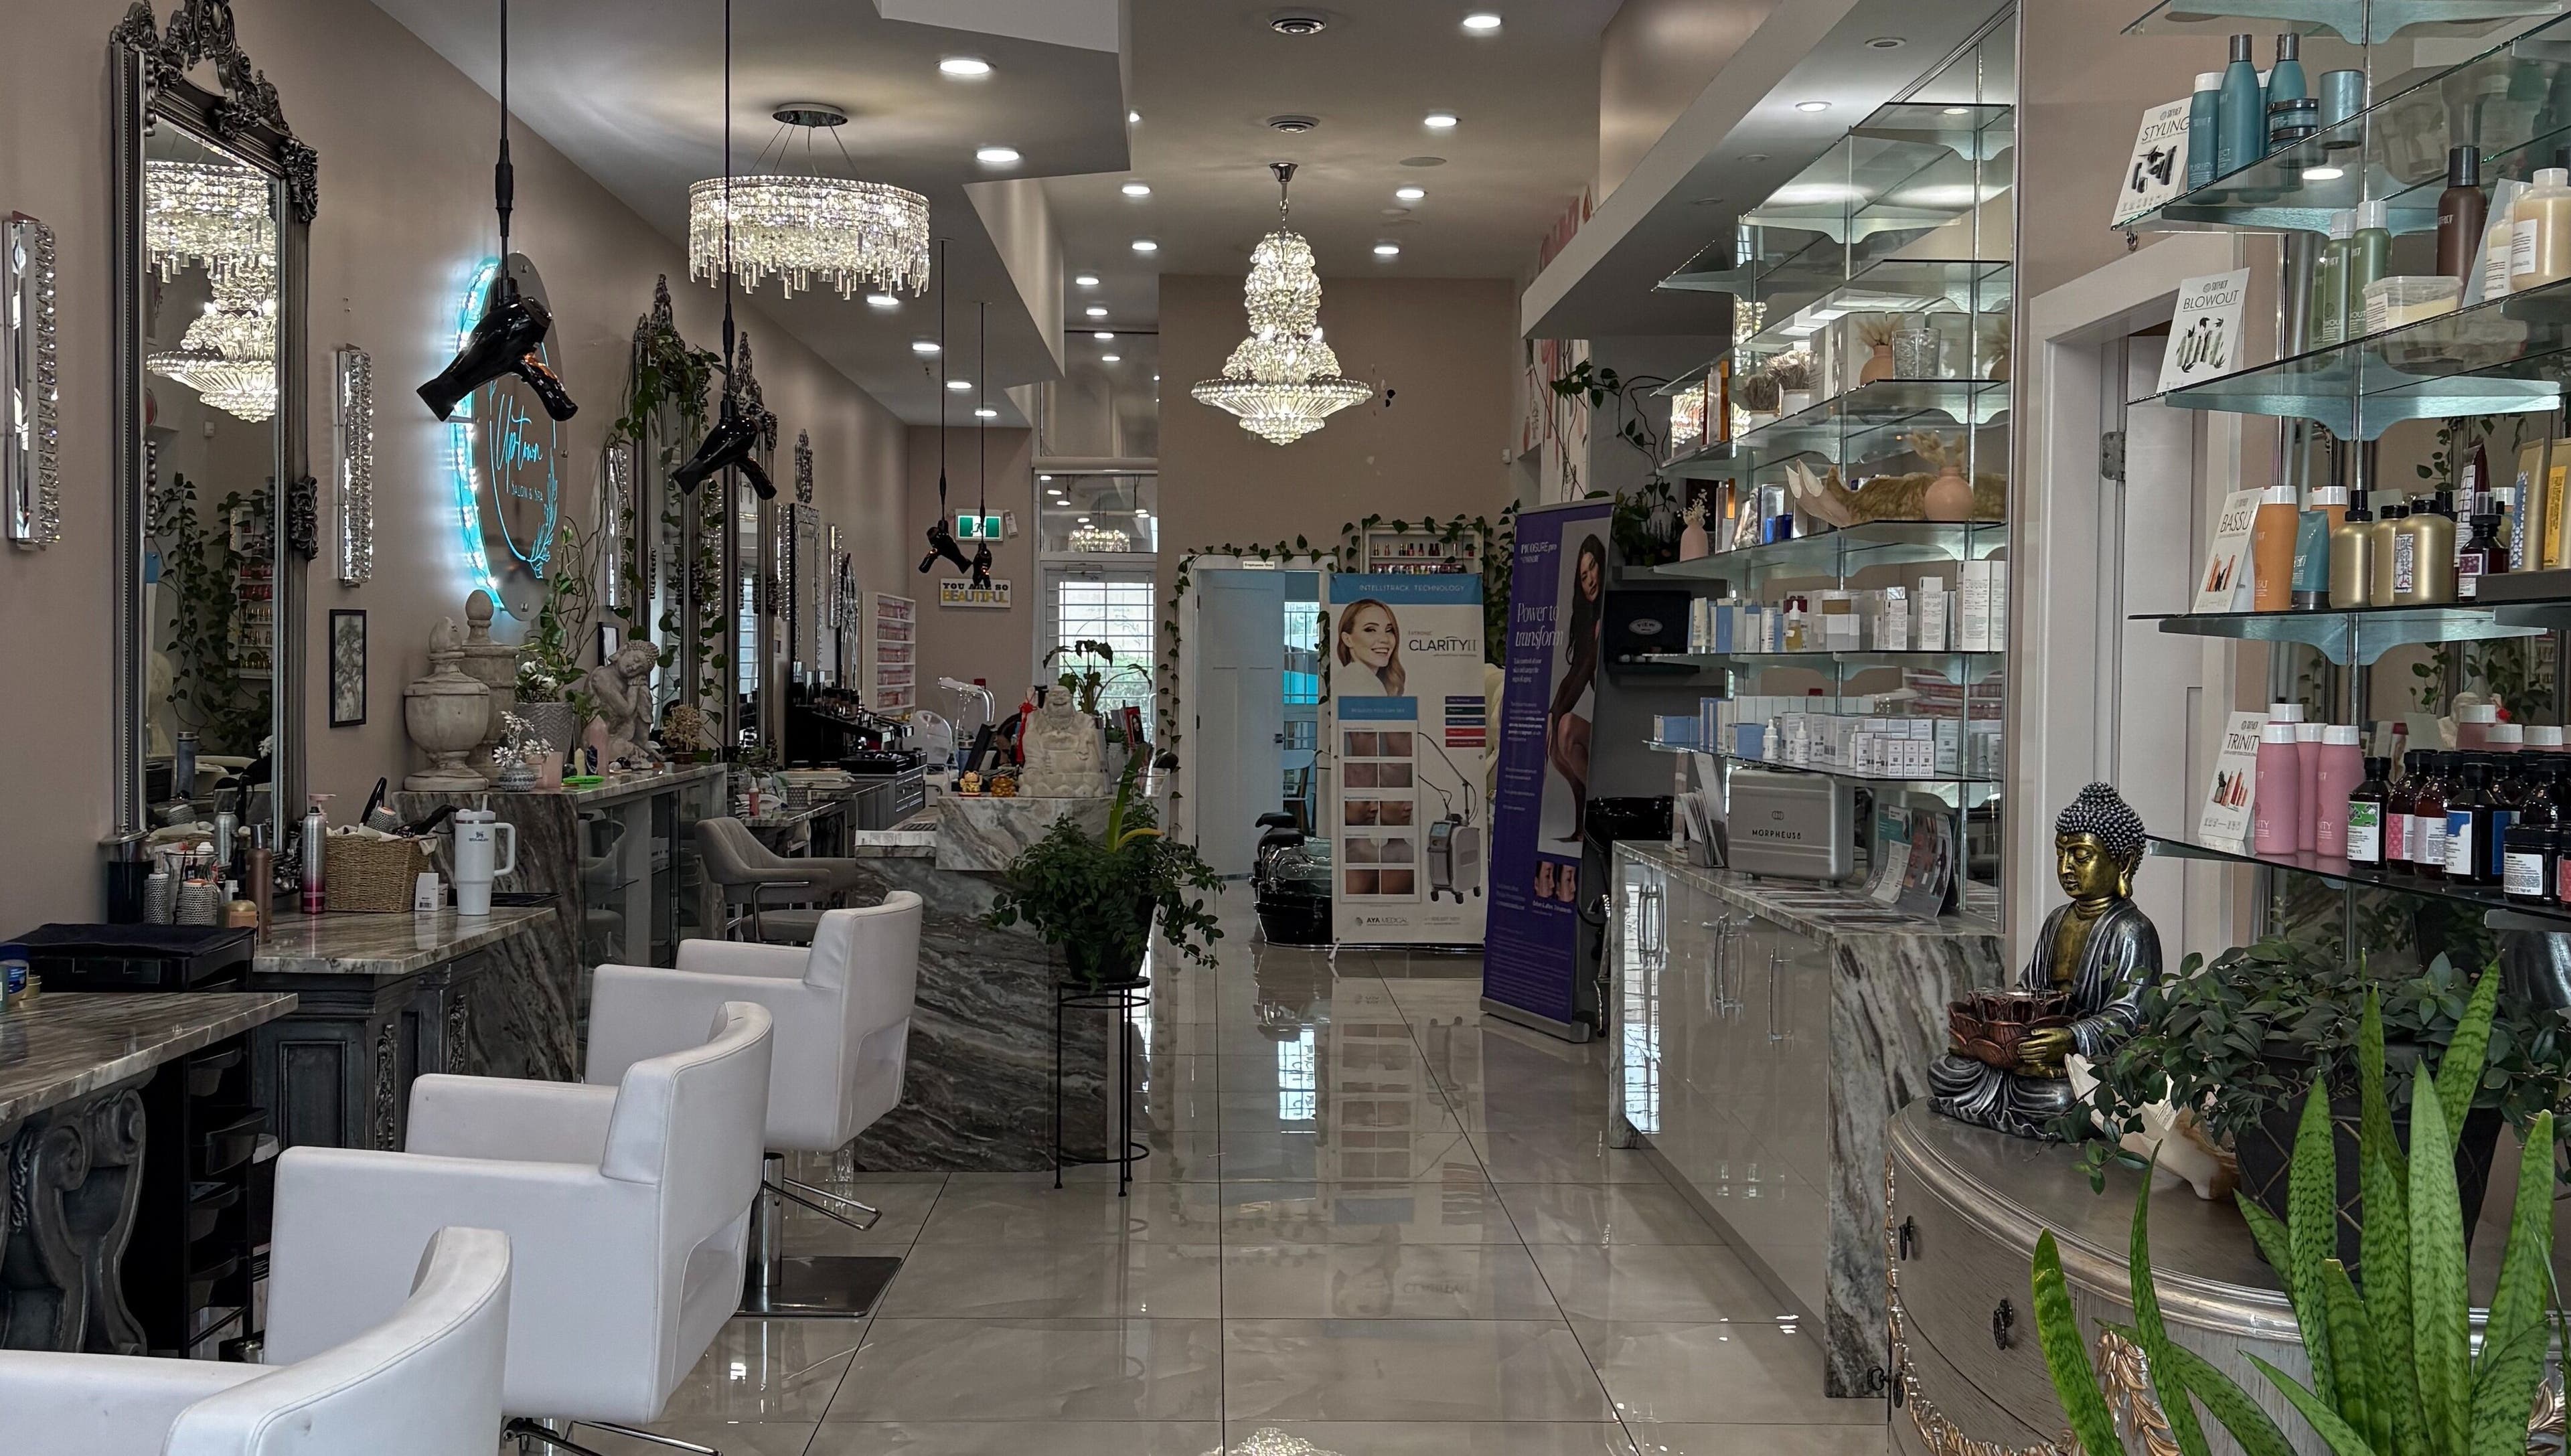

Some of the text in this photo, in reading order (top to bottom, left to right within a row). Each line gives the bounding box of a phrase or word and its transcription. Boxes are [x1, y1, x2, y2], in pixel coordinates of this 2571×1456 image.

[2142, 116, 2189, 141] STYLING
[2183, 289, 2240, 310] BLOWOUT
[496, 394, 543, 493] Uptown
[2219, 511, 2253, 533] BASSU
[942, 590, 1008, 603] BEAUTIFUL
[1414, 584, 1465, 592] TECHNOLOGY
[1517, 602, 1559, 623] Power to
[1515, 625, 1563, 650] transform
[1751, 829, 1801, 839] MORPHEUS8
